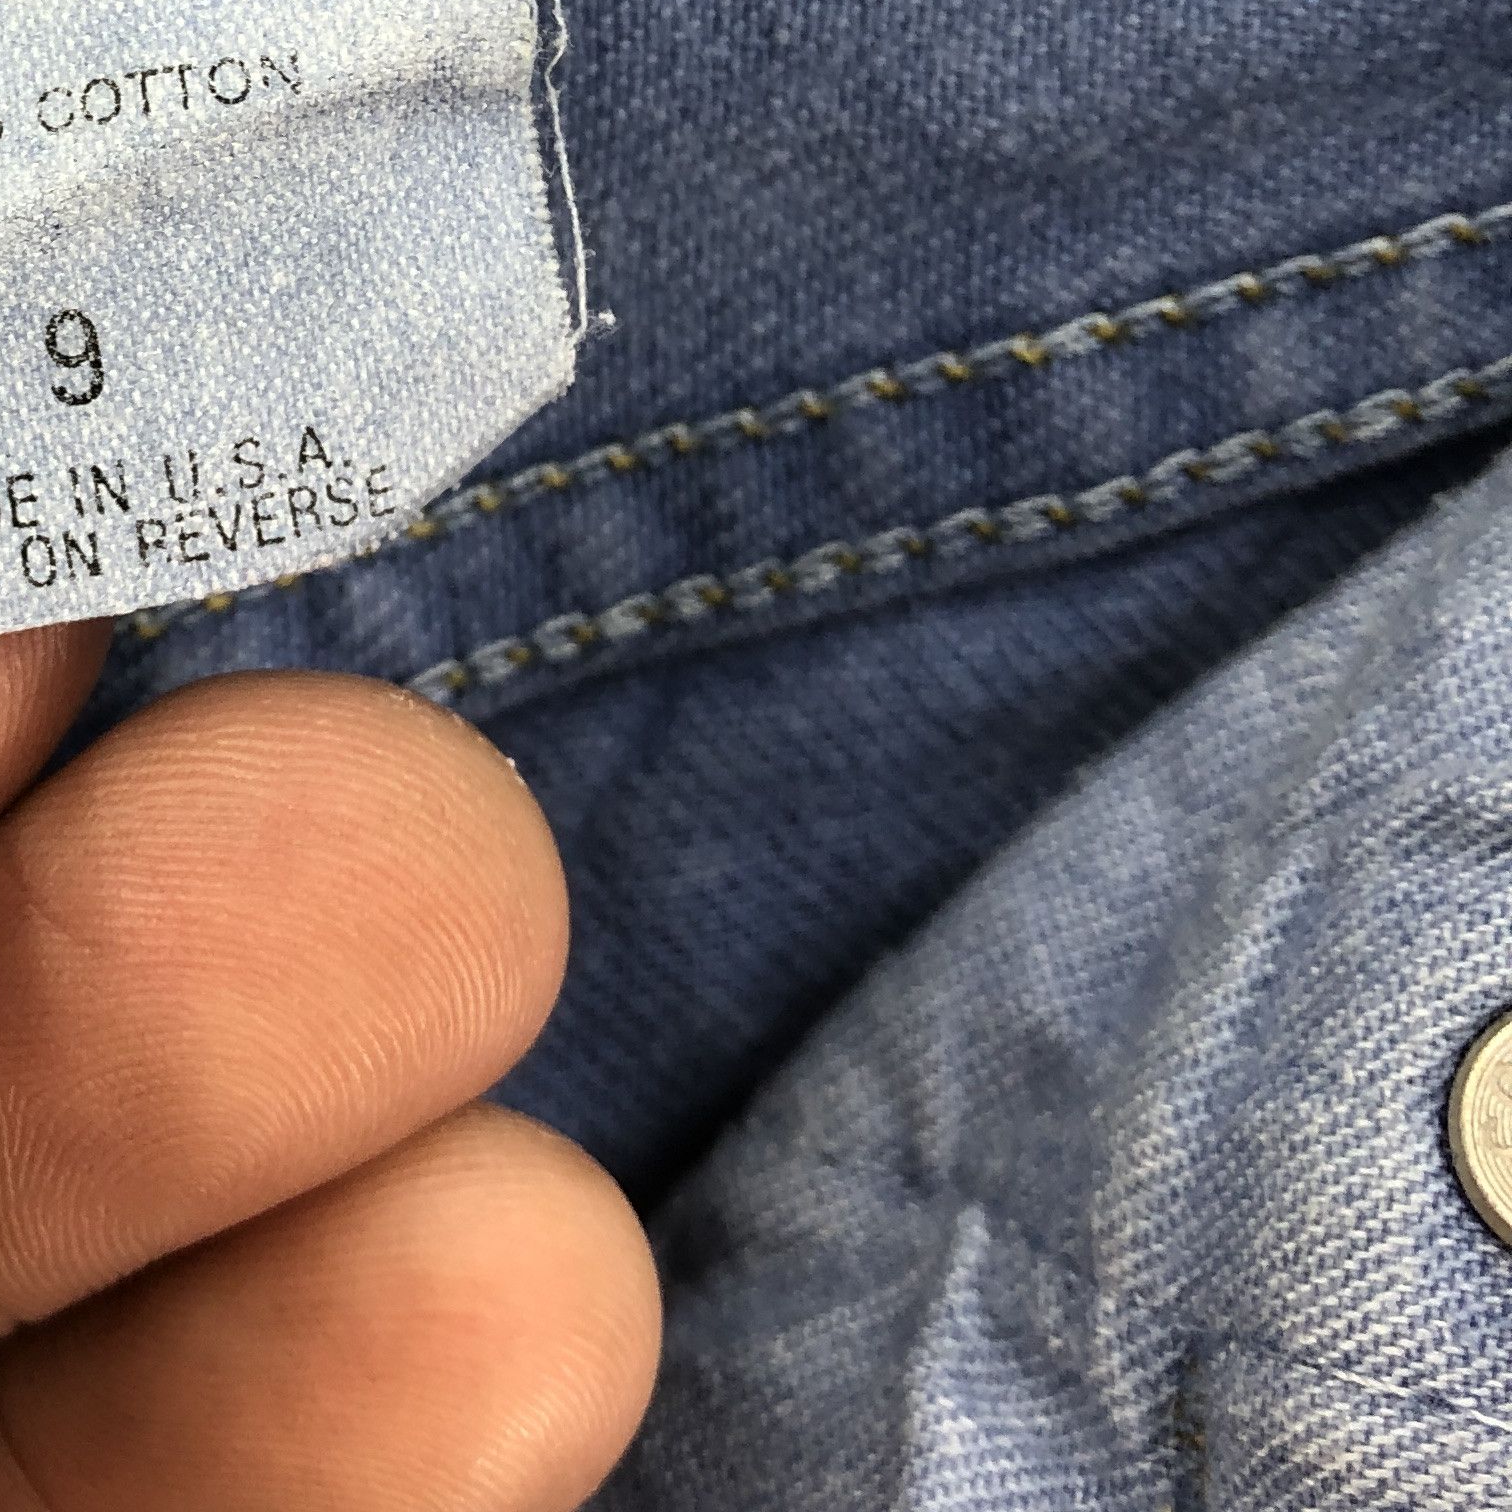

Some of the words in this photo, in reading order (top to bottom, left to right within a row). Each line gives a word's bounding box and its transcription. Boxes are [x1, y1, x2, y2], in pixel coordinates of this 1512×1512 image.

[37, 50, 303, 133] COTTON
[44, 308, 105, 406] 9
[67, 458, 131, 518] IN
[162, 424, 354, 504] U.S.A.
[21, 531, 105, 589] ON
[135, 463, 397, 569] REVERSE
